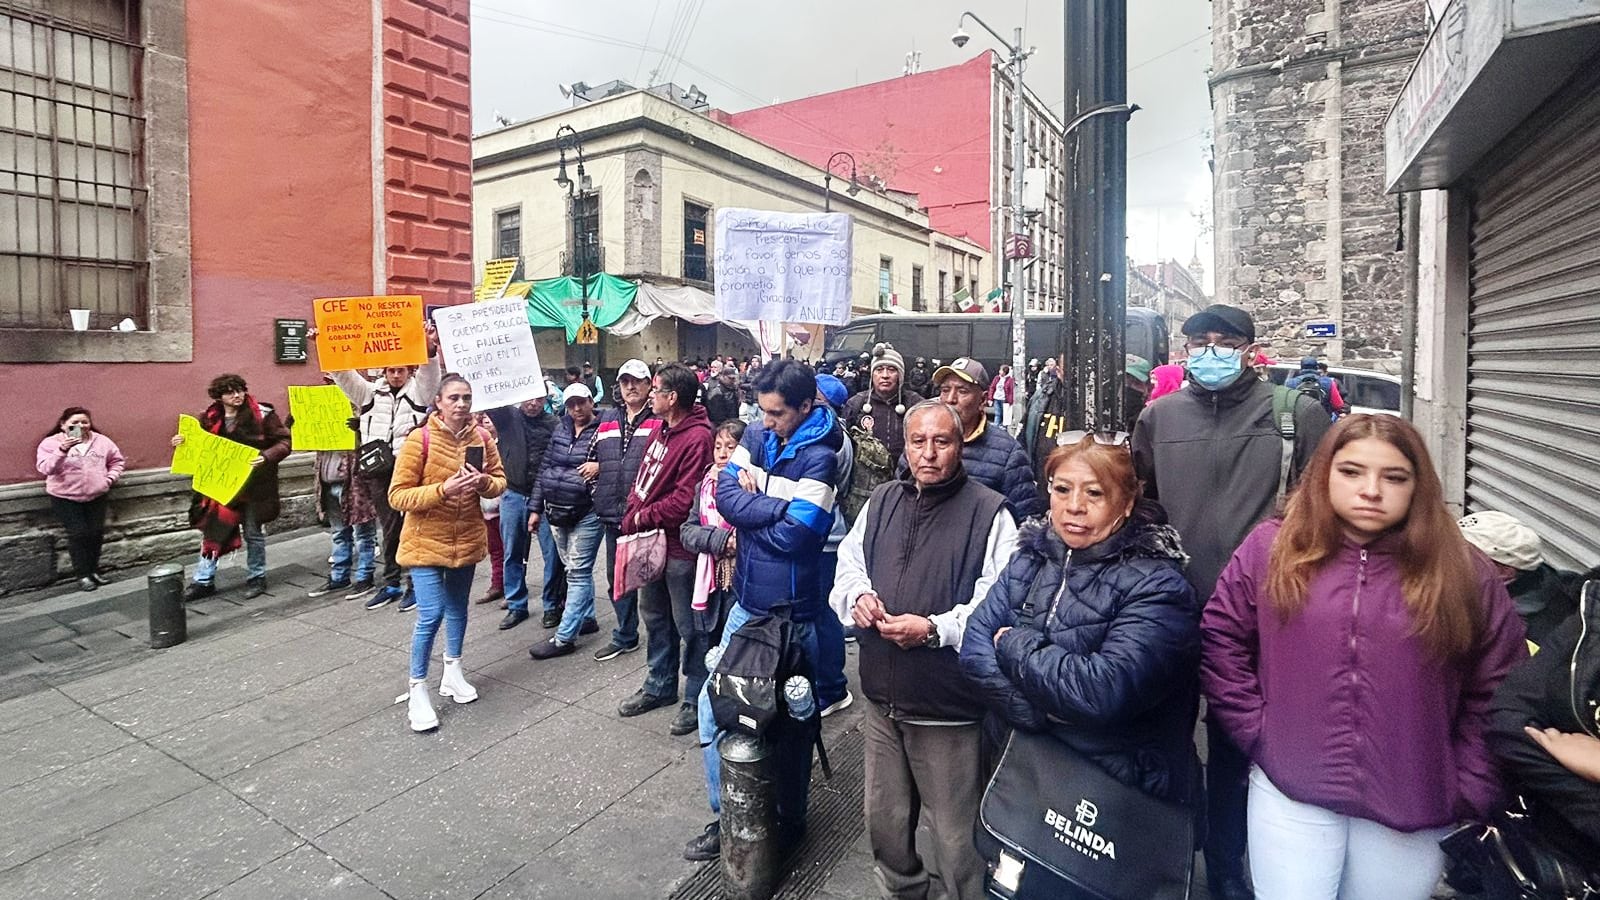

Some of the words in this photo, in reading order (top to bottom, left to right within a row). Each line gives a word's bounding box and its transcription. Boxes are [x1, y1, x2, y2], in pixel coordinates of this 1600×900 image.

[757, 266, 766, 274] a
[793, 265, 814, 279] que
[823, 266, 848, 277] nos
[322, 299, 349, 312] CFE
[359, 303, 373, 311] NO
[378, 301, 412, 310] RESPETA
[471, 302, 523, 319] PRESIDENTE
[800, 305, 841, 321] ANUEE
[366, 310, 402, 319] ACUERDOS
[326, 323, 363, 333] FIRMADOS
[328, 333, 361, 341] GOBIERNO
[367, 331, 398, 339] FEDERAL
[331, 345, 337, 353] Y
[341, 344, 352, 352] LA
[363, 338, 403, 354] ANUEE
[452, 343, 468, 354] EL
[476, 333, 513, 348] ANUEE
[456, 352, 493, 368] CONFIO
[1044, 808, 1116, 860] BELINDA
